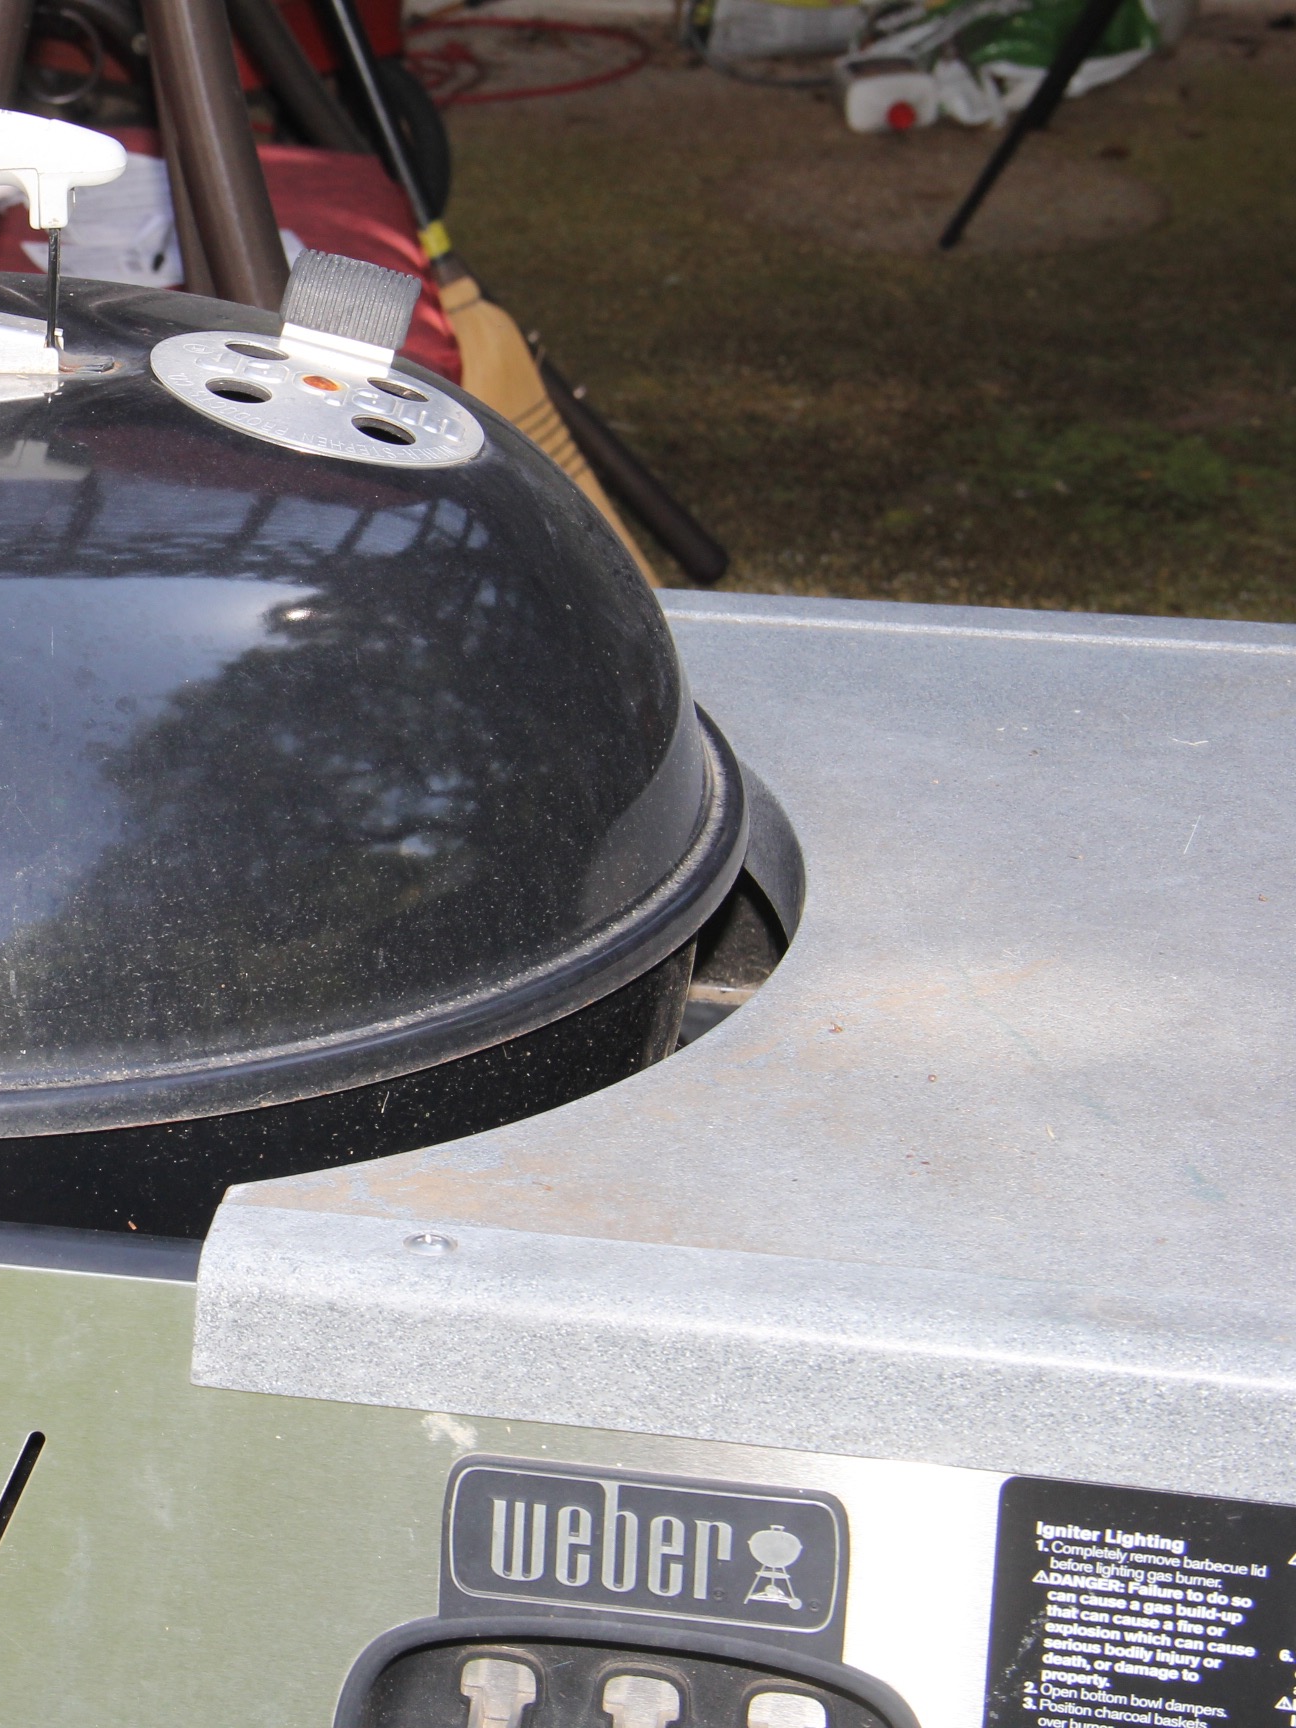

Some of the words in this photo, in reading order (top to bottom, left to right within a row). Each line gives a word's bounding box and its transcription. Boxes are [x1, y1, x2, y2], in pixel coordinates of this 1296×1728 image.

[490, 1481, 733, 1600] weber
[1036, 1521, 1102, 1542] Igniter
[1104, 1528, 1186, 1556] Lighting
[1035, 1538, 1050, 1553] 1.
[1051, 1540, 1128, 1565] Completely
[1129, 1552, 1182, 1568] remove
[1182, 1555, 1249, 1576] barbecue
[1250, 1563, 1268, 1578] lid
[1049, 1556, 1095, 1575] before
[1095, 1561, 1146, 1583] lighting
[1146, 1570, 1174, 1584] gas
[1174, 1570, 1223, 1589] burner.
[1047, 1571, 1126, 1594] DANGER:
[1127, 1581, 1185, 1601] Failure
[1185, 1588, 1205, 1603] to
[1205, 1591, 1230, 1606] do
[1230, 1596, 1254, 1609] so
[1047, 1590, 1078, 1604] can
[1078, 1592, 1128, 1610] cause
[1128, 1600, 1142, 1612] a
[1142, 1601, 1174, 1616] gas
[1175, 1602, 1244, 1625] build-up
[1045, 1603, 1080, 1621] that
[1079, 1610, 1111, 1624] can
[1111, 1614, 1161, 1630] cause
[1162, 1620, 1175, 1632] a
[1175, 1619, 1205, 1636] fire
[1205, 1625, 1227, 1638] or
[1043, 1637, 1103, 1655] serious
[1103, 1642, 1155, 1664] bodily
[1155, 1648, 1202, 1669] injury
[1202, 1657, 1223, 1670] or
[1044, 1620, 1122, 1641] explosion
[1123, 1630, 1173, 1648] which
[1173, 1637, 1205, 1652] can
[1206, 1641, 1257, 1658] cause
[1279, 1648, 1295, 1663] 6.
[1041, 1651, 1092, 1672] death,
[1093, 1659, 1114, 1672] or
[1113, 1660, 1180, 1682] damage
[1181, 1668, 1200, 1683] to
[1041, 1669, 1111, 1690] property.
[1022, 1696, 1038, 1711] 3.
[1038, 1698, 1093, 1717] Position
[1094, 1706, 1153, 1725] charcoal
[1153, 1712, 1208, 1728] baskets
[1023, 1681, 1039, 1695] 2.
[1040, 1682, 1079, 1700] Open
[1080, 1687, 1129, 1706] bottom
[1130, 1693, 1164, 1710] bowl
[1164, 1698, 1228, 1718] dampers.
[1037, 1717, 1069, 1728] over
